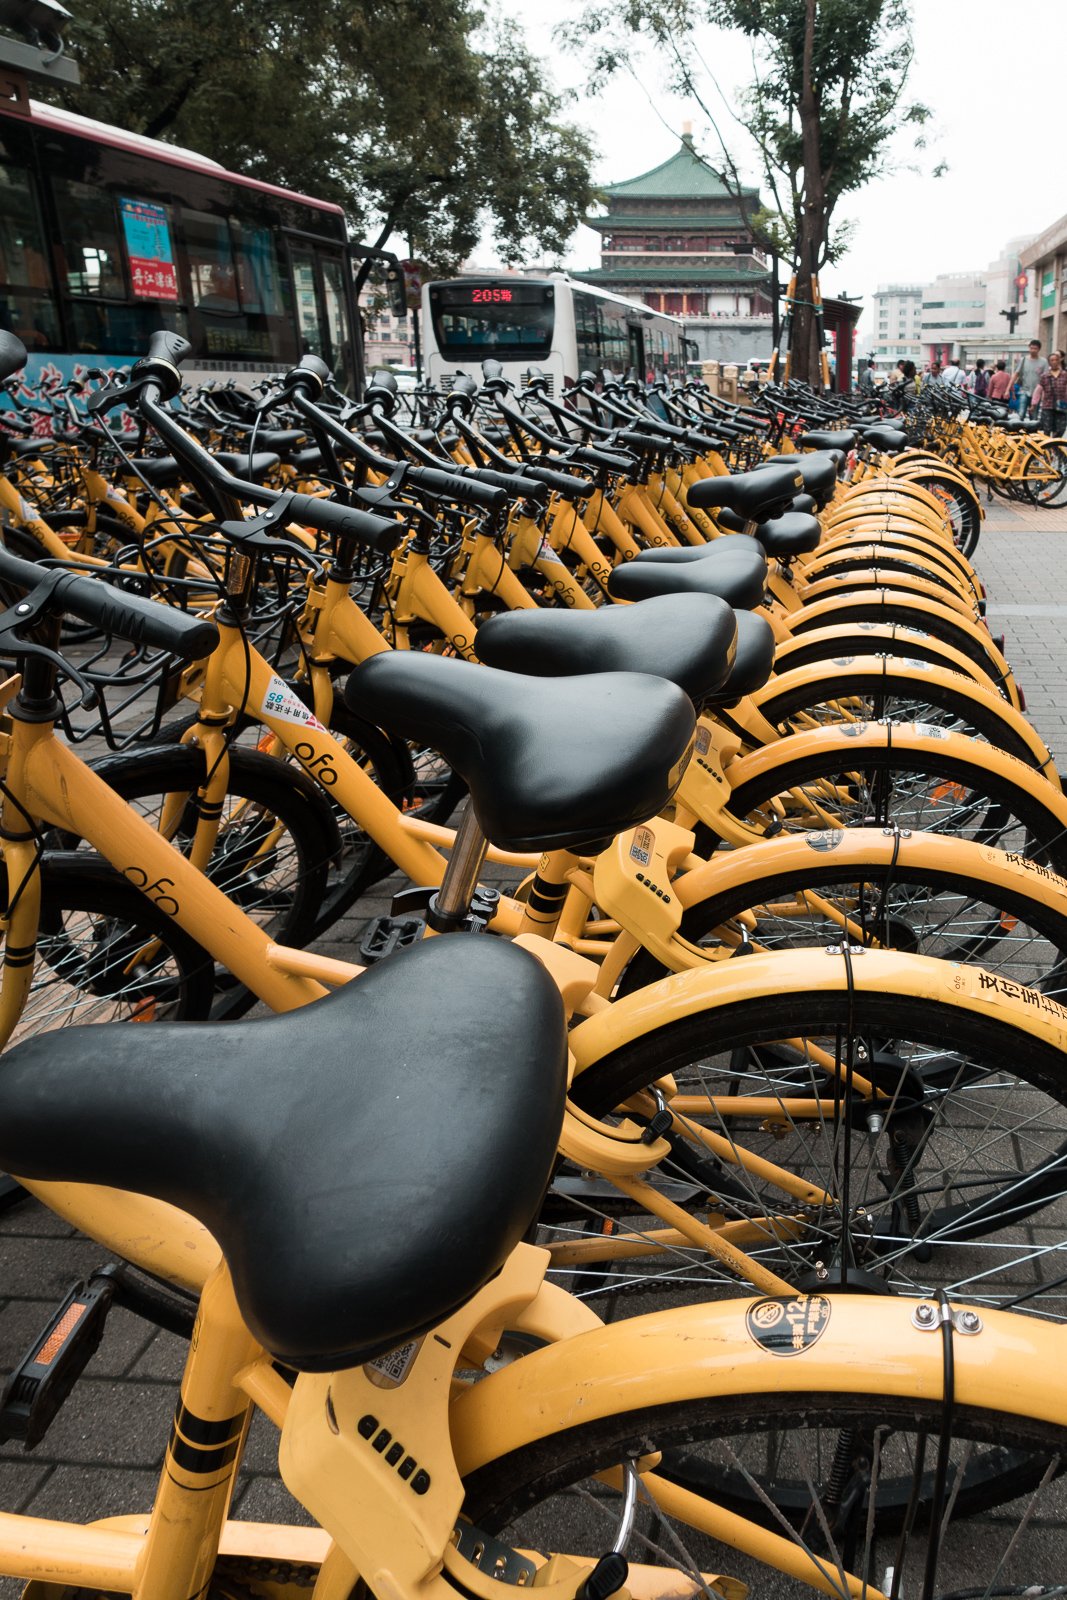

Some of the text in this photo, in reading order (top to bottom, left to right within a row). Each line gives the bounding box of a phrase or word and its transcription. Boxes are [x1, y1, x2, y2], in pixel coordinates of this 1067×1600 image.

[554, 580, 576, 606] ofo
[268, 692, 284, 703] 85
[295, 742, 338, 785] ofo
[122, 866, 179, 916] ofo
